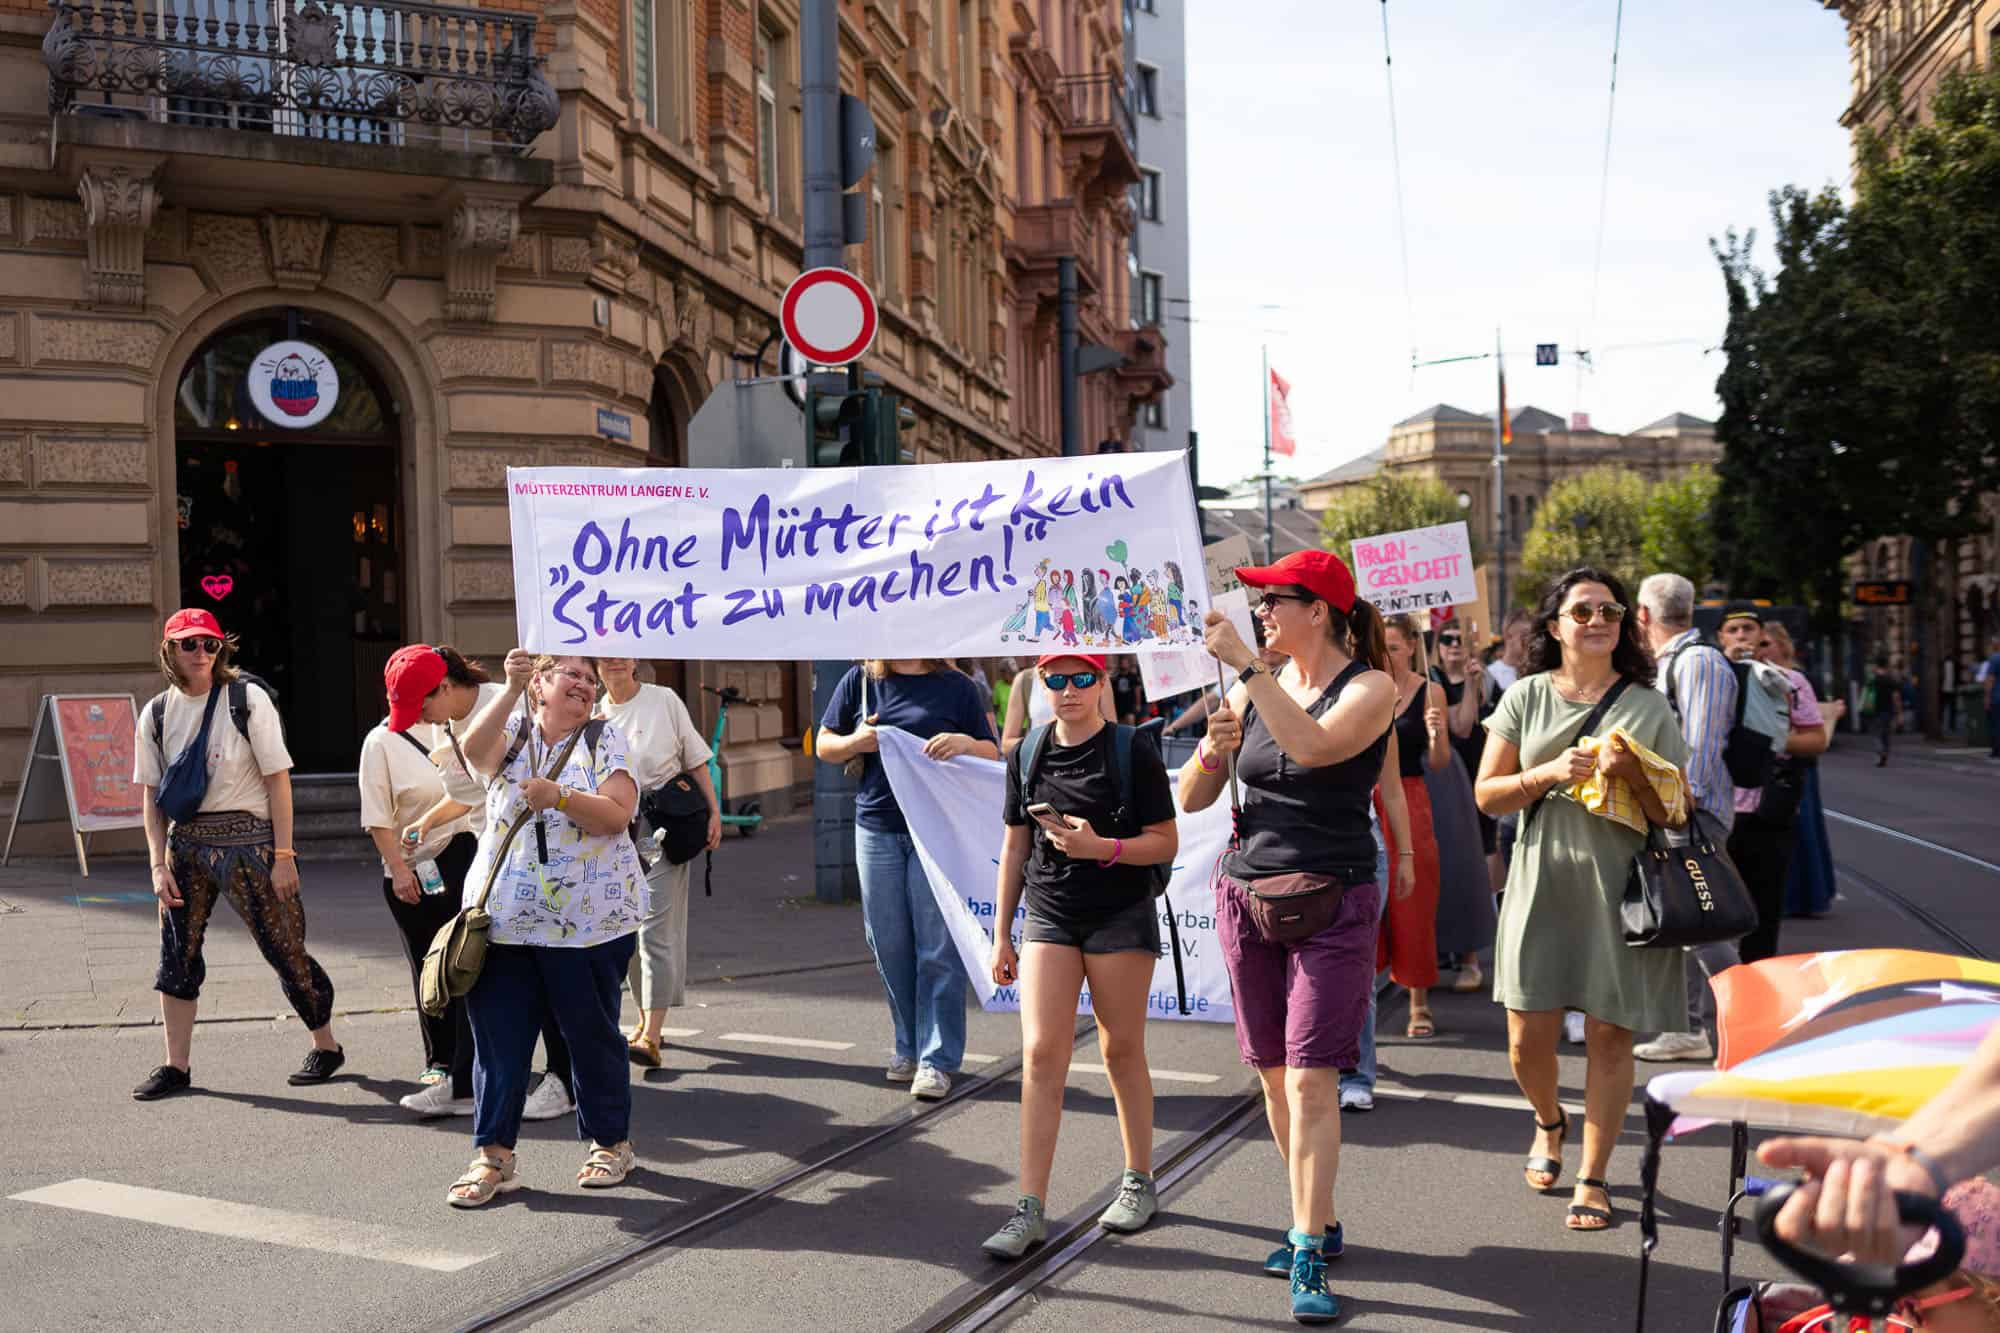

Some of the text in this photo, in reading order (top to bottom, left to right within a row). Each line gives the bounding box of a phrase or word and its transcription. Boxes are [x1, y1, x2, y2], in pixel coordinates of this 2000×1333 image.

[515, 482, 709, 499] MÜTTERZENTRUM LANGEN E. V.
[720, 493, 911, 576] Mütter
[925, 483, 1006, 541] ist
[1010, 470, 1135, 526] kein
[552, 580, 707, 645] Staat
[721, 588, 785, 625] zu
[1684, 857, 1715, 912] GUESS
[1182, 938, 1199, 958] V.
